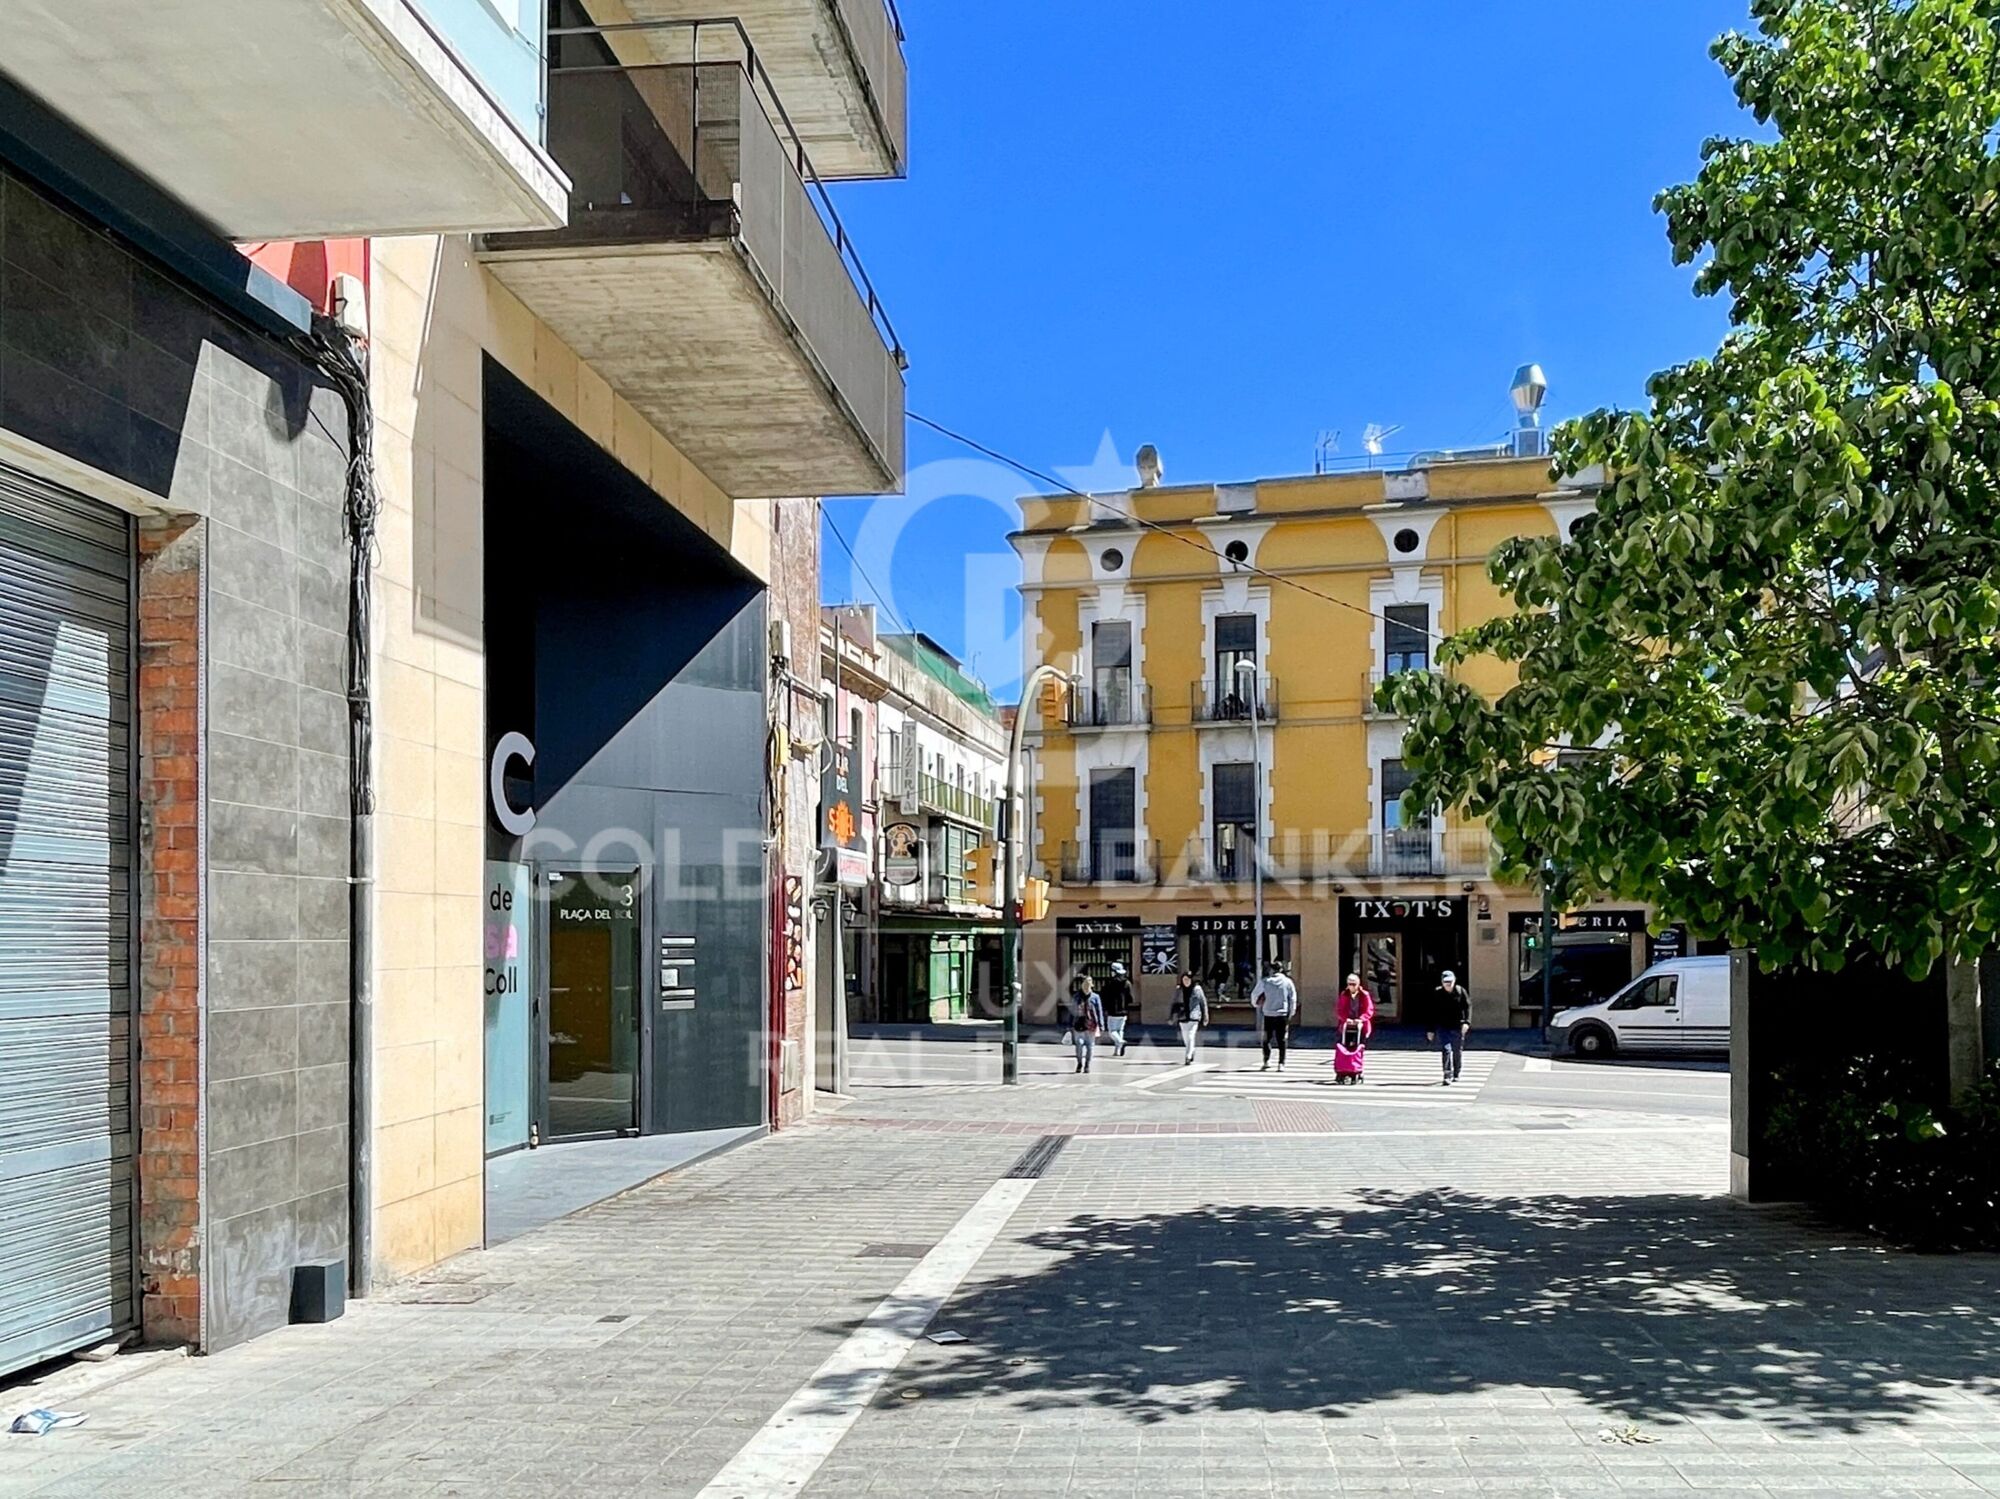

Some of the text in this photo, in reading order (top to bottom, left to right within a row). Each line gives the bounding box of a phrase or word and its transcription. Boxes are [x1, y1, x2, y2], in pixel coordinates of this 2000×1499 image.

[489, 883, 512, 911] de
[620, 884, 633, 907] 3
[560, 908, 593, 922] PLAÇA
[594, 908, 612, 920] DEL
[1523, 916, 1628, 927] SIDERIA
